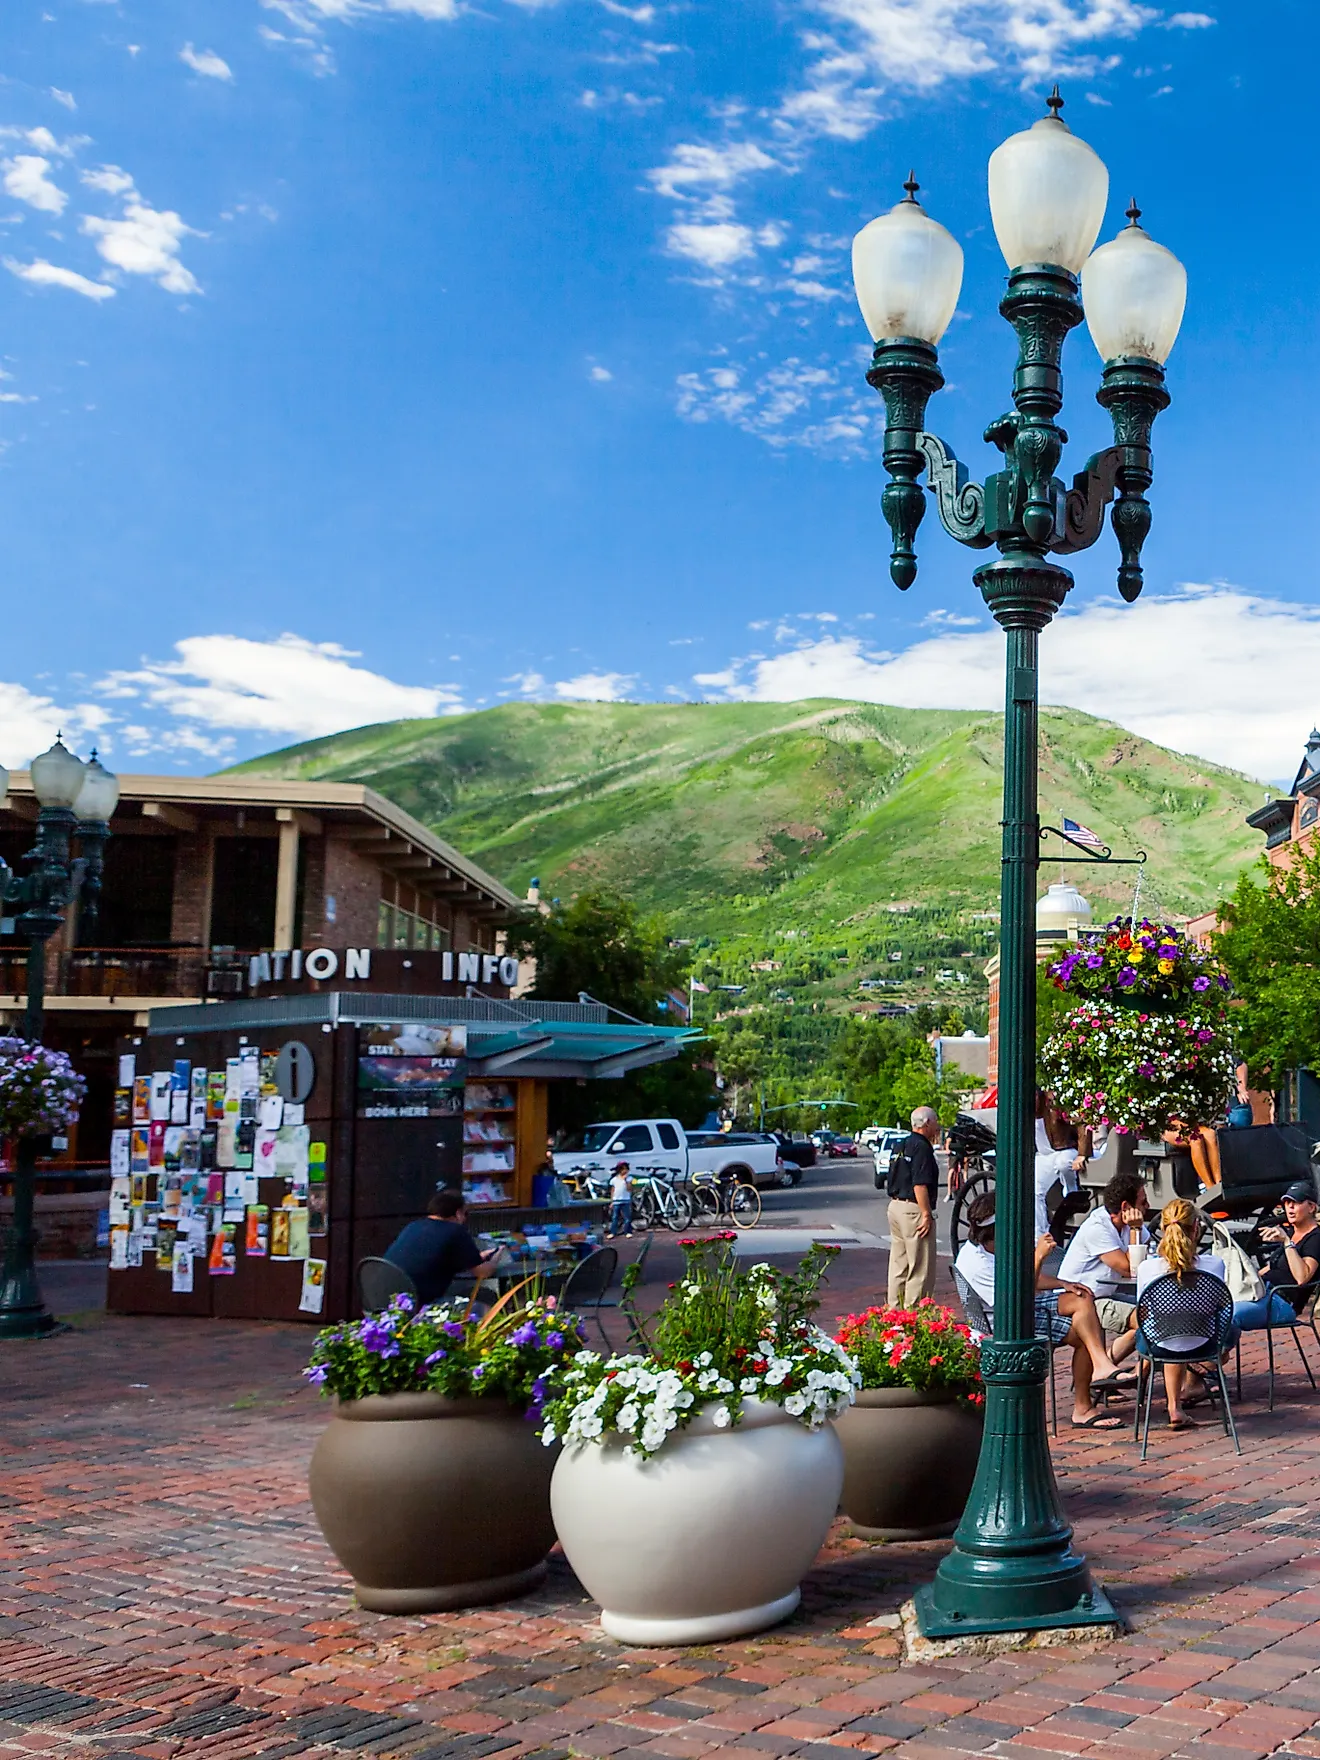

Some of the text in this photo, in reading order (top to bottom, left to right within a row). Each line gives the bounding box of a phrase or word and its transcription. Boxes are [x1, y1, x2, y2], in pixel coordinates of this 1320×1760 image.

[442, 951, 519, 986] INFO
[368, 1044, 394, 1056] STAY
[431, 1058, 457, 1068] PLAY
[365, 1106, 429, 1118] BOOK HERE
